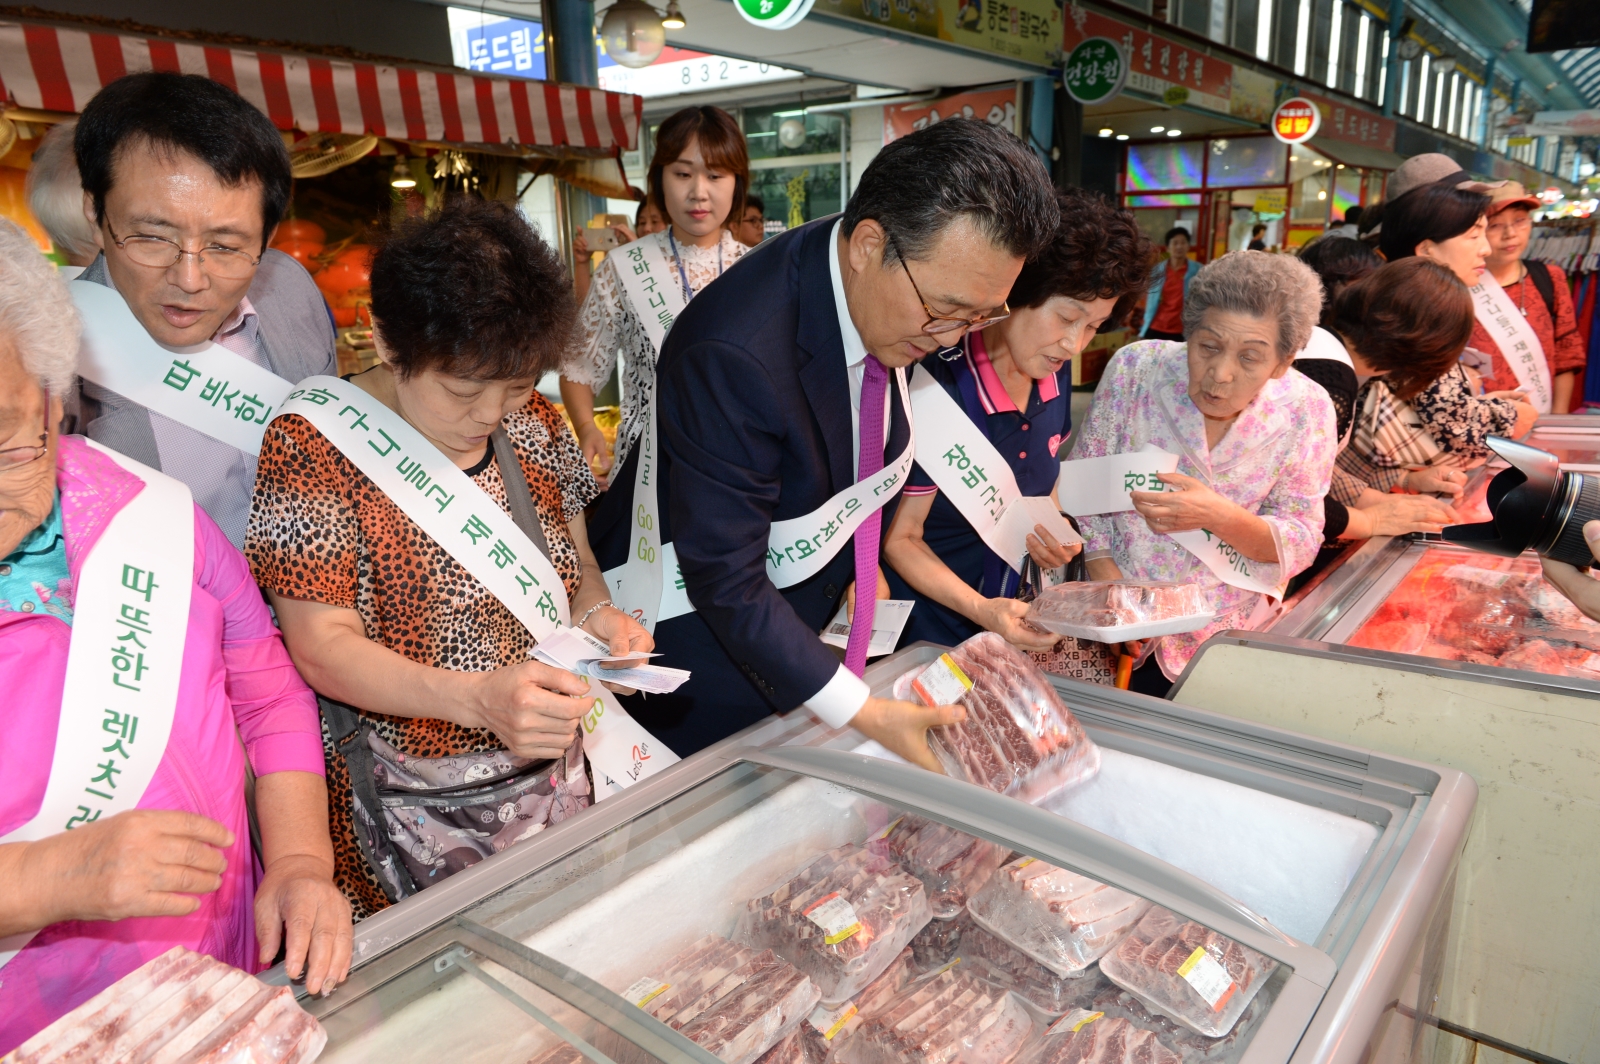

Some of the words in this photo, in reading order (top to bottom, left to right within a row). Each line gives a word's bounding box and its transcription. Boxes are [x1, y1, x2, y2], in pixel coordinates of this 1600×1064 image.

[1020, 10, 1051, 43] 칼국수
[470, 27, 532, 72] 두드림
[1079, 45, 1106, 60] 자연
[681, 60, 788, 85] 832-0
[1066, 58, 1119, 87] 건강원
[1277, 116, 1310, 134] 김밥
[1470, 282, 1518, 339] 바구니들고
[162, 359, 273, 425] 따뜻한
[943, 443, 1008, 525] 장바구니
[1124, 470, 1179, 493] 장바
[637, 504, 653, 531] Go
[637, 536, 656, 564] Go
[111, 563, 160, 692] 따뜻한
[582, 697, 605, 735] Go
